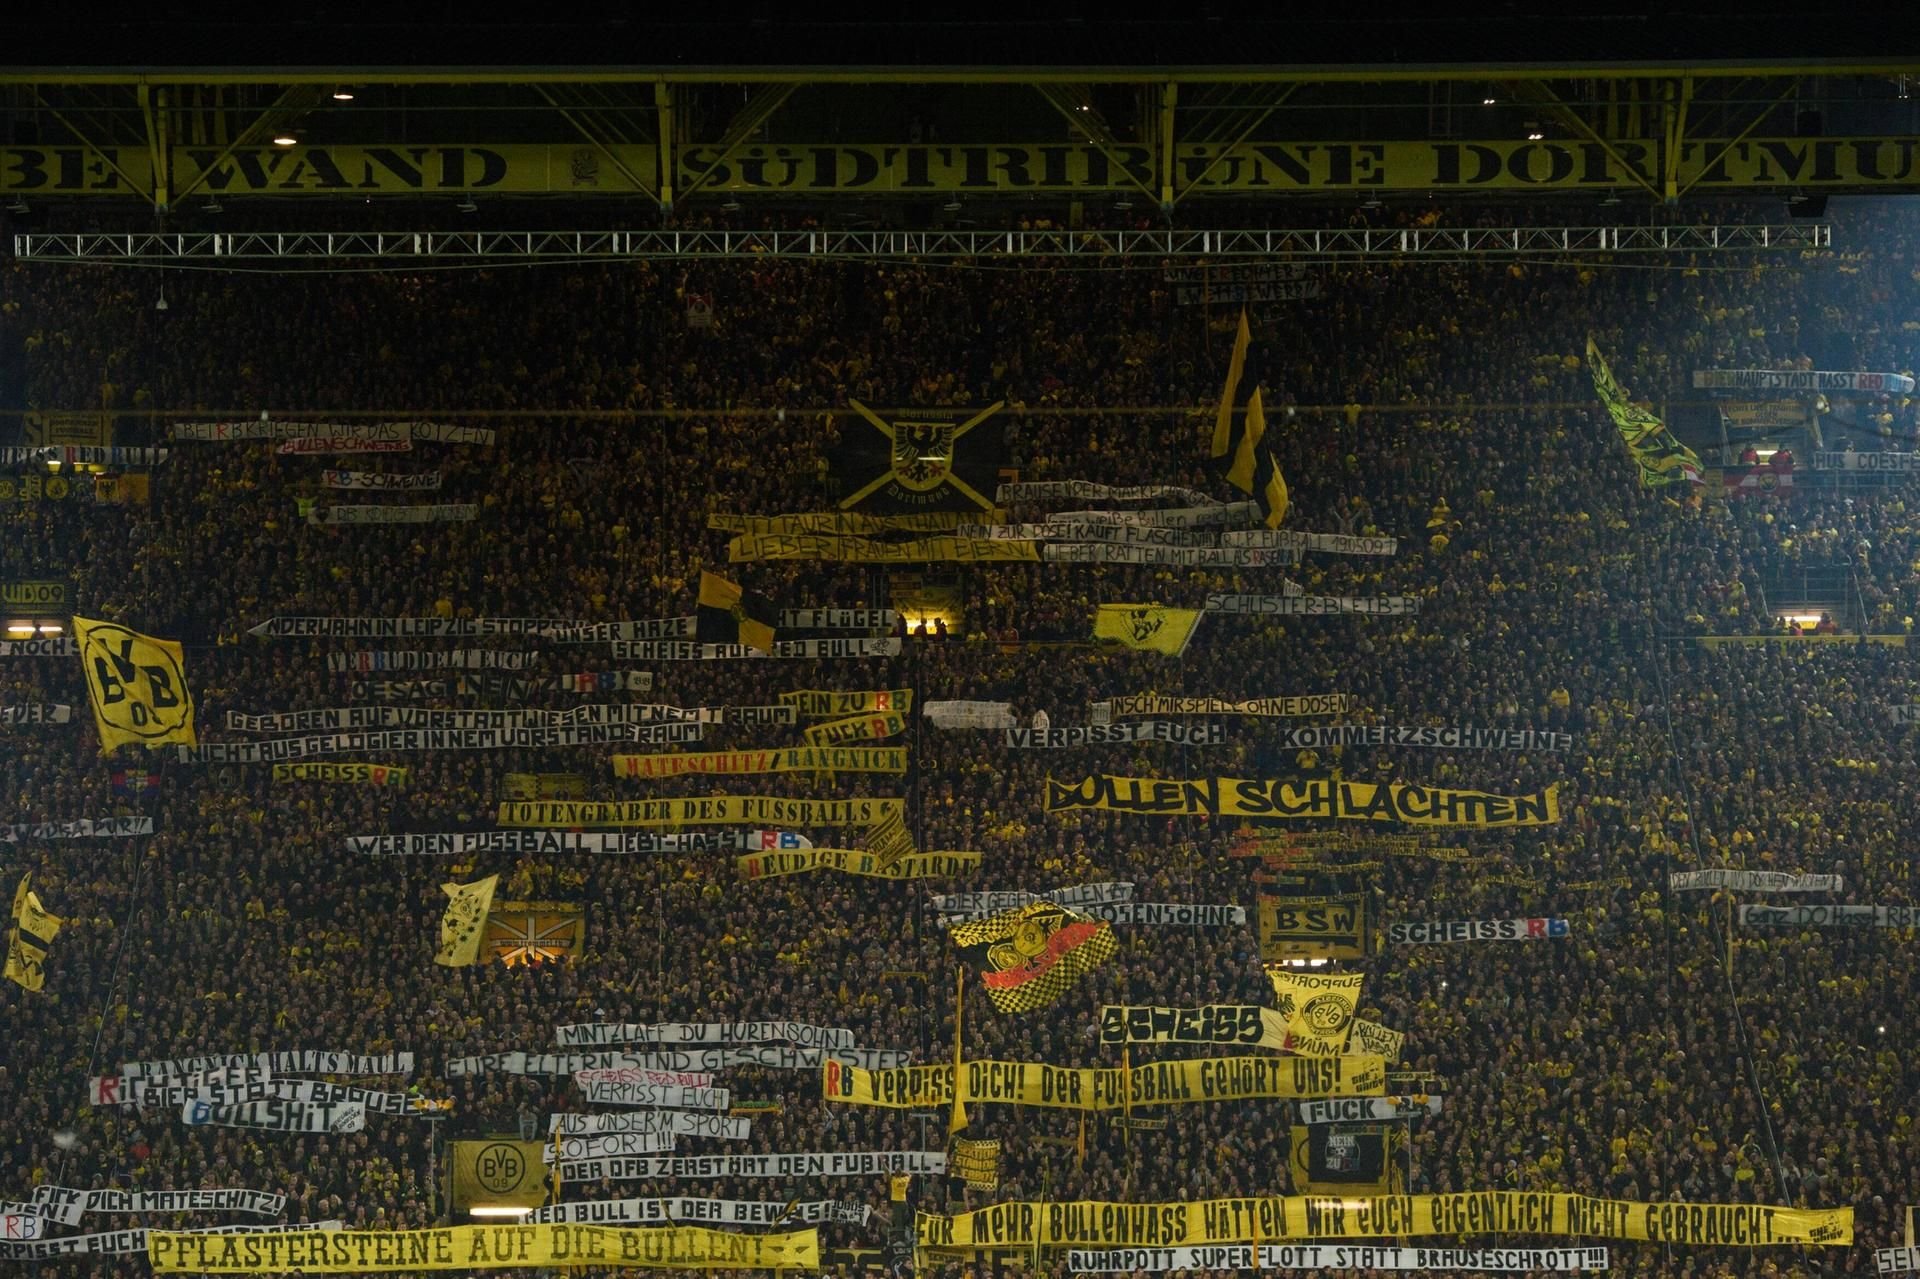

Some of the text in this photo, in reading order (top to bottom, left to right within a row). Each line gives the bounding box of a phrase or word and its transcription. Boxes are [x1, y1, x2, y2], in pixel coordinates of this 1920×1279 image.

[186, 149, 508, 189] WAND
[401, 619, 477, 635] LEIPZIG
[556, 623, 622, 642] UNSER
[633, 618, 688, 638] HAZE
[817, 639, 870, 657] BULL
[837, 691, 867, 712] ZU
[875, 690, 907, 712] RB
[231, 711, 340, 731] GEBOREN
[350, 709, 394, 729] AUF
[1011, 720, 1571, 751] VERPISST EUCH KOMMERZSCHWEINE
[277, 764, 368, 782] SCHEISS
[683, 799, 872, 822] DES FUSSBALLS
[1235, 780, 1550, 823] SCHLACHTEN
[462, 832, 591, 851] FUSSBALL
[760, 830, 801, 849] RB
[1276, 908, 1356, 932] BSW
[1390, 917, 1567, 944] SCHEISS RB
[679, 1024, 706, 1041] DU
[524, 1052, 613, 1075] ELTERN
[827, 1061, 854, 1097] RB
[1293, 1056, 1342, 1093] UNS!
[1311, 1098, 1376, 1122] FUCK
[683, 1113, 746, 1137] SPORT
[483, 1148, 518, 1178] BVB
[562, 1161, 604, 1181] DER
[610, 1159, 650, 1177] DFB
[778, 1156, 824, 1175] DEN
[492, 1177, 509, 1189] 09
[575, 1203, 631, 1222] BULL
[681, 1200, 723, 1219] DER
[5, 1215, 37, 1239] RB
[87, 1231, 147, 1251] EUCH
[152, 1225, 763, 1268] PFLASTERSTEINE AUF DIE BULLEN!
[1070, 1248, 1177, 1271] RUHRPOTT
[1336, 1246, 1400, 1267] STATT
